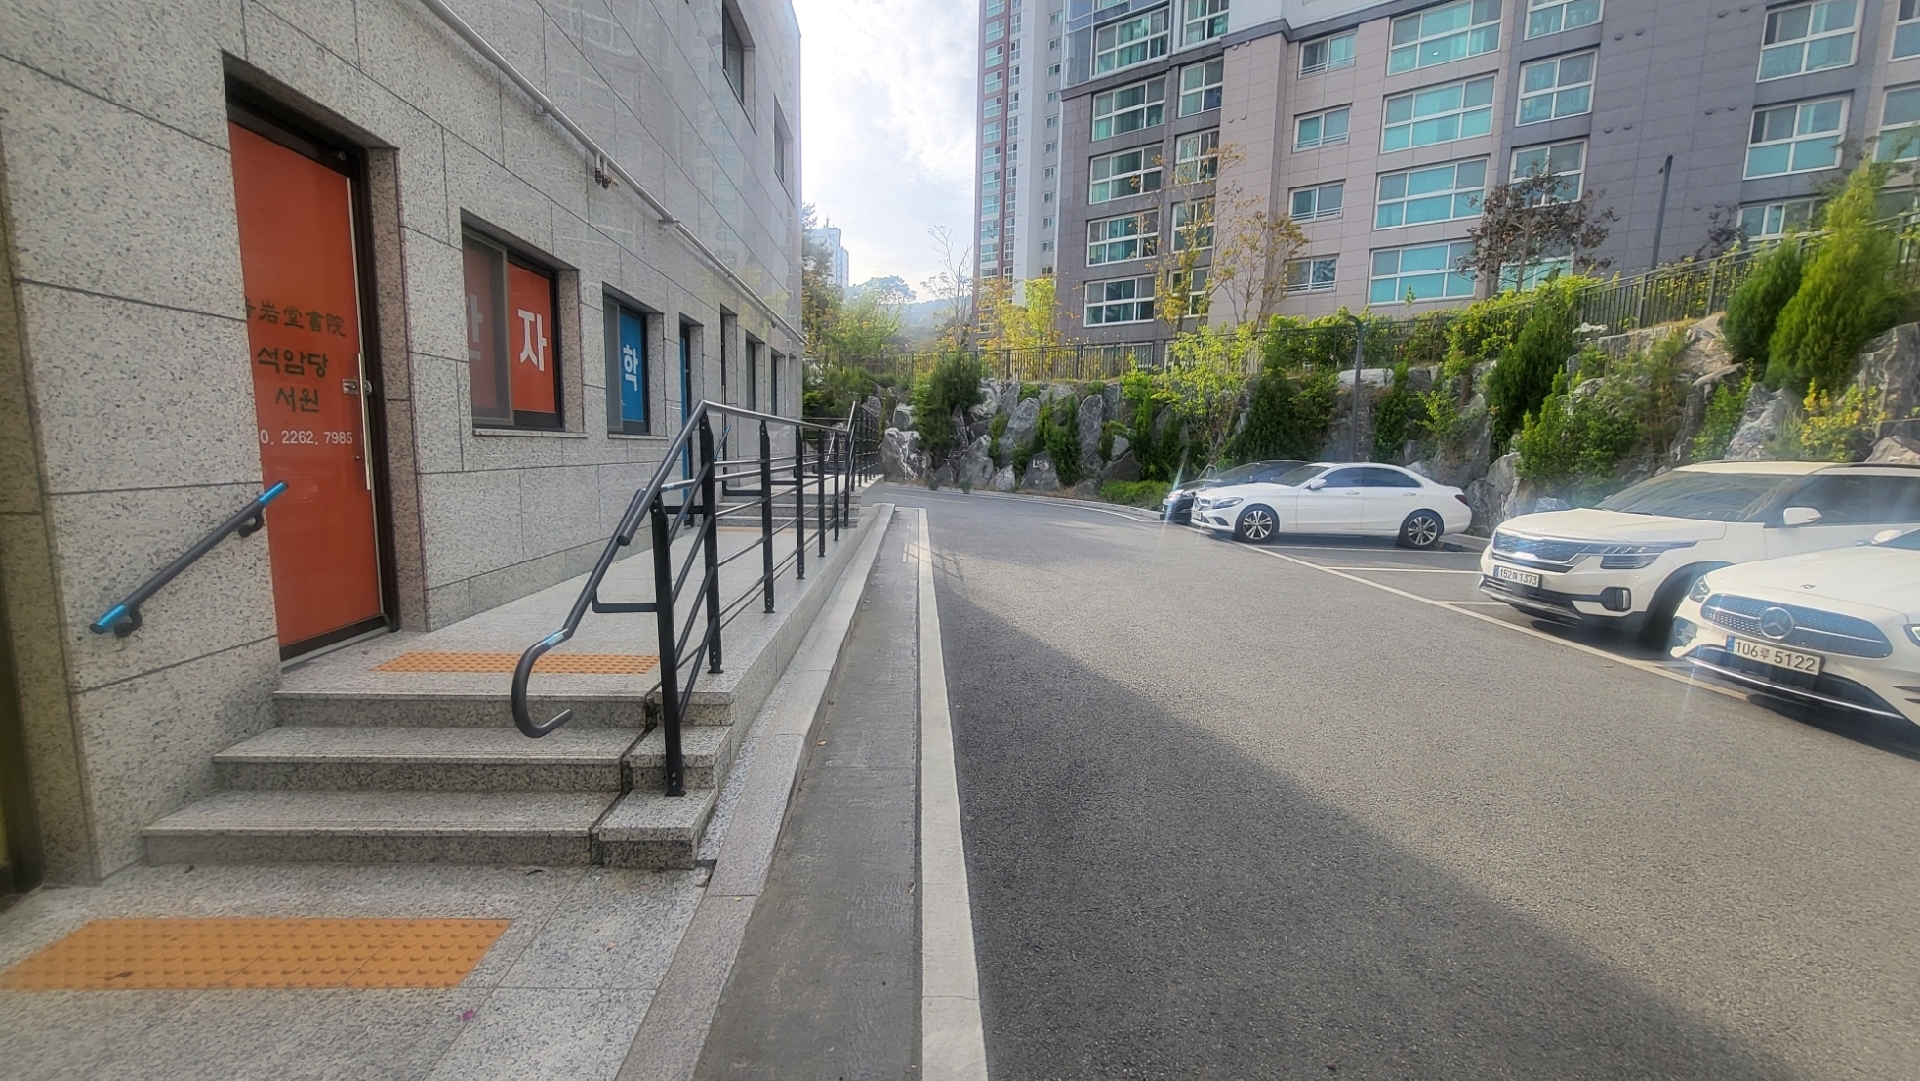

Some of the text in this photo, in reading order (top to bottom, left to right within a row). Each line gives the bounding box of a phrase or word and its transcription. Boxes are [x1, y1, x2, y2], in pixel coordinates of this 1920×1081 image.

[517, 309, 547, 372] 자
[258, 347, 329, 378] 석암당
[623, 344, 638, 392] 학
[275, 386, 320, 413] 서원
[324, 431, 353, 445] 7985
[1520, 572, 1537, 586] 1373
[1774, 650, 1815, 672] 5122
